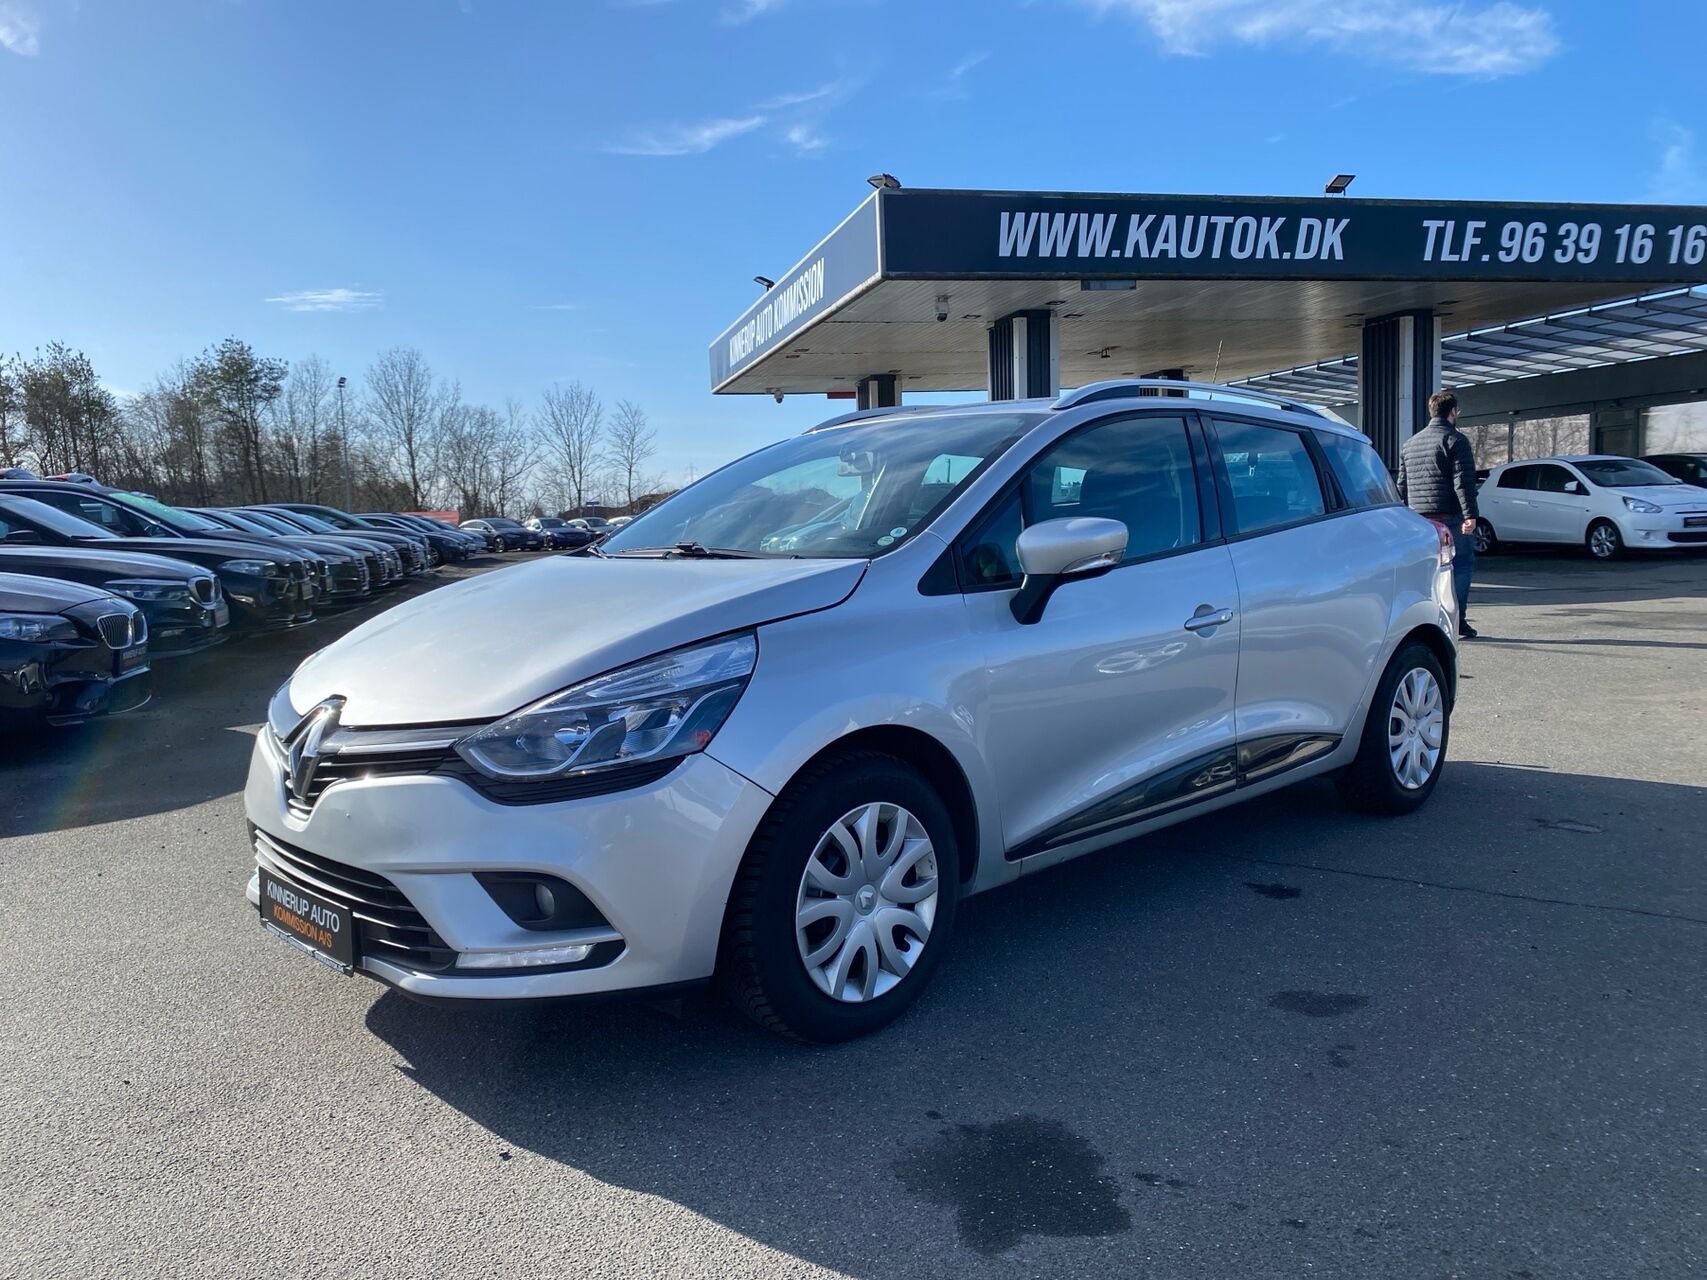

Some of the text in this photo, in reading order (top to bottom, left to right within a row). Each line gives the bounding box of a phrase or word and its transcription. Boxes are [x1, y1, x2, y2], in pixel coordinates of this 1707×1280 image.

[999, 211, 1350, 261] WWW.KAUTOK.DK
[1422, 219, 1707, 265] TLF. 96 39 16 16
[730, 257, 825, 367] KINNERUP AUTO KOMMISSION
[267, 880, 340, 932] KINNERUP AUTO
[273, 905, 333, 948] KOMMISSION A/S
